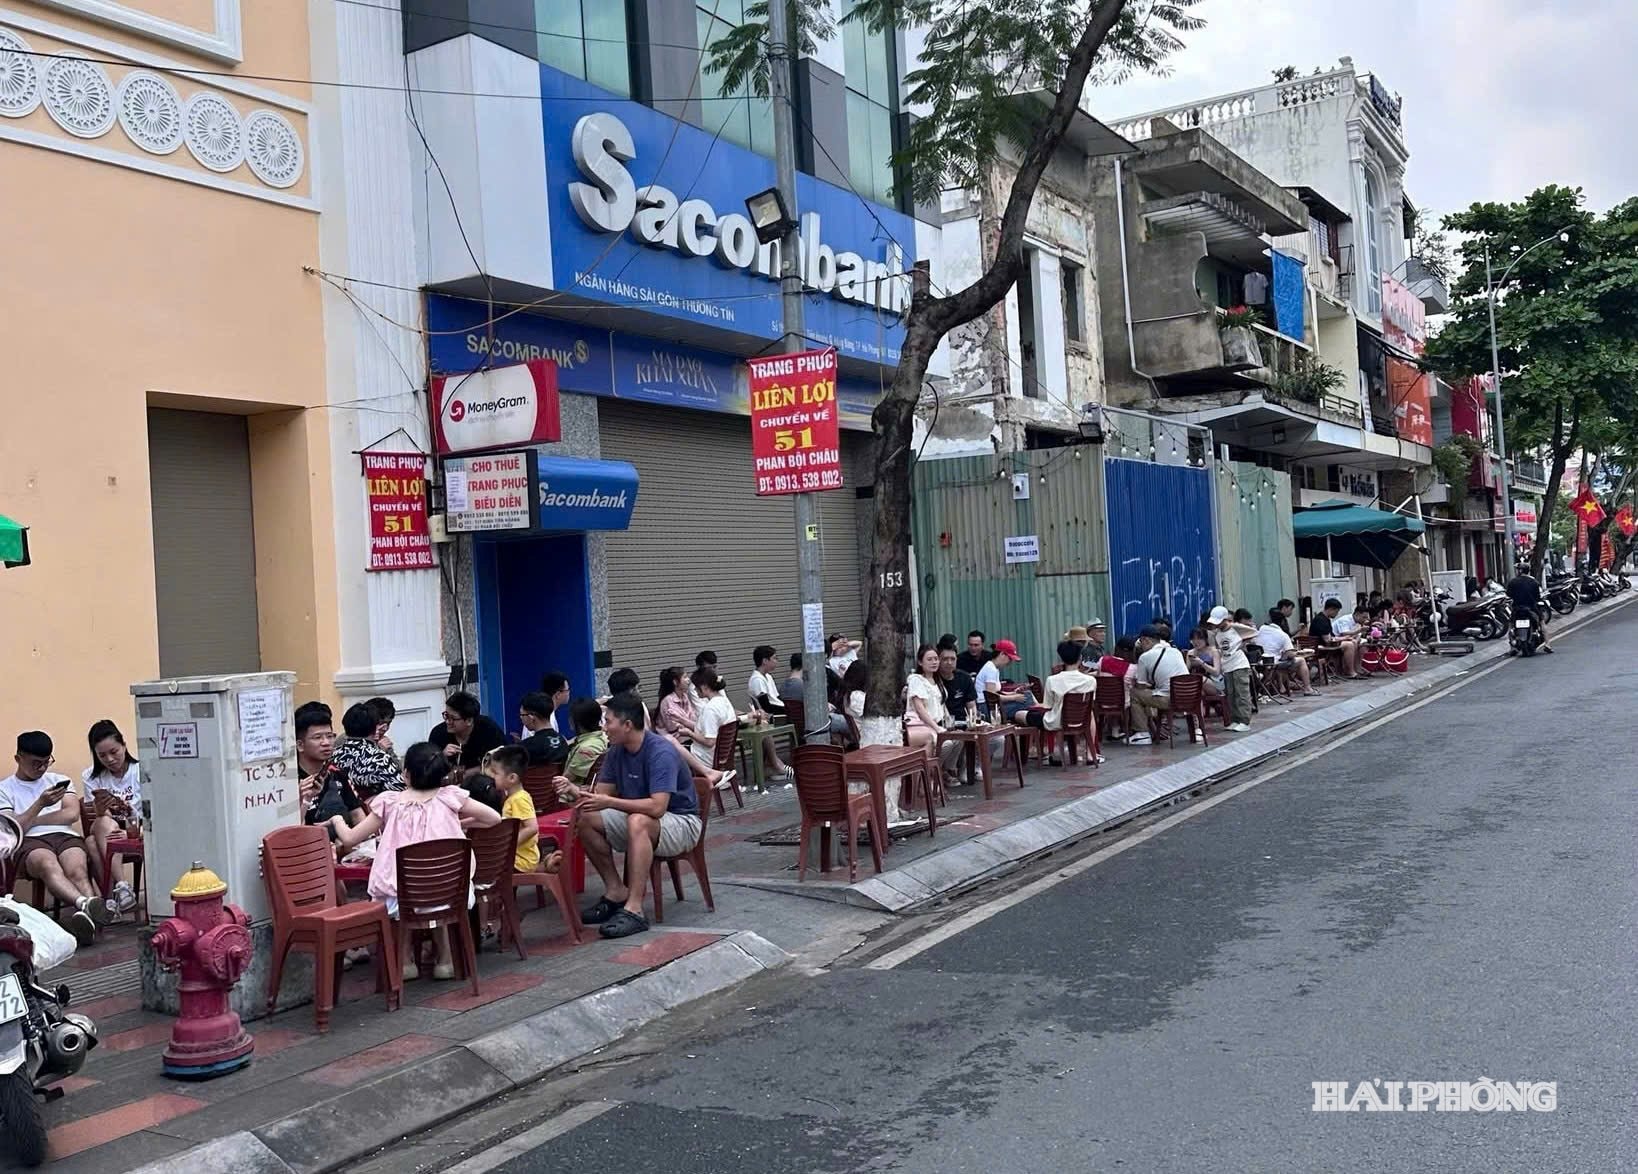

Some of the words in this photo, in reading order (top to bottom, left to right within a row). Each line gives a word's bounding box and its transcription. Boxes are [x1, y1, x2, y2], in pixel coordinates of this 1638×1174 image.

[575, 271, 607, 293] NGÂN
[608, 279, 639, 300] HÀNG
[639, 286, 656, 303] SÀI
[658, 290, 680, 309] GÒN
[719, 305, 735, 322] TÍN
[466, 333, 574, 369] SACOMBANK
[751, 359, 794, 380] TRANG
[797, 353, 834, 374] PHỤC
[753, 382, 796, 411] LIÊN
[801, 378, 835, 408] LỢI
[467, 396, 527, 414] MoneyGram
[774, 427, 817, 452] 51
[365, 456, 396, 469] TRANG
[398, 456, 423, 473] PHỤC
[472, 461, 492, 473] CHO
[494, 456, 520, 471] THUÊ
[756, 456, 786, 471] PHAN
[788, 451, 807, 470] BỘI
[809, 448, 839, 466] CHÂU
[368, 474, 399, 496] LIÊN
[402, 476, 426, 500] LỢI
[468, 479, 499, 492] TRANG
[501, 477, 528, 491] PHỤC
[759, 477, 774, 492] ĐT:
[802, 471, 820, 488] 538
[821, 469, 839, 486] 002
[539, 482, 628, 508] Sacombank
[384, 515, 416, 533] 51
[371, 536, 393, 549] PHAN
[394, 534, 408, 550] BỘI
[409, 533, 430, 547] CHÂU
[404, 551, 417, 565] 538
[418, 551, 431, 564] 002
[880, 571, 903, 589] 153
[244, 767, 261, 782] TC
